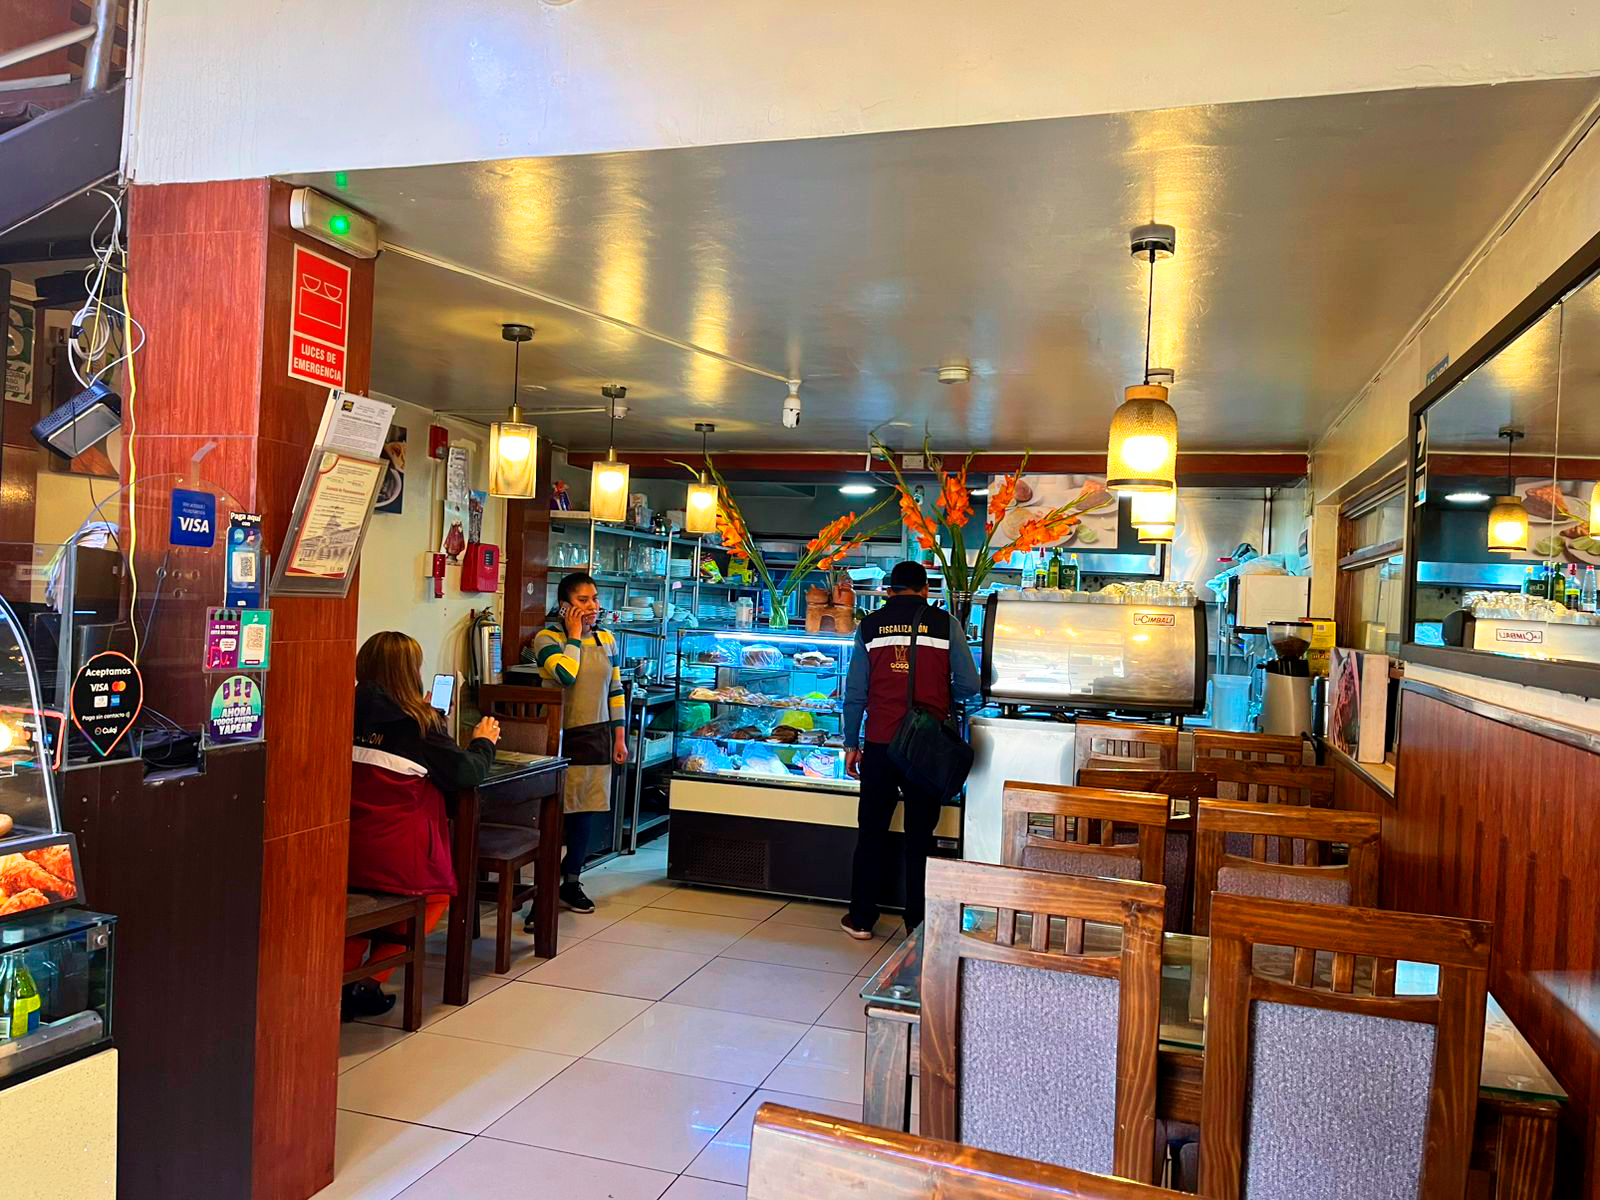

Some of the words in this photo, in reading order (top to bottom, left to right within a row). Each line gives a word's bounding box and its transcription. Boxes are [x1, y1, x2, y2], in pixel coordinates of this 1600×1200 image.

[301, 343, 325, 361] LUCES
[326, 351, 337, 365] DE
[293, 356, 342, 382] EMERGENCIA
[230, 512, 246, 522] Paga
[247, 513, 262, 522] aquí
[178, 516, 209, 533] VISA
[879, 622, 928, 634] FISCALIZAÓN
[85, 668, 132, 678] Aceptamos
[90, 682, 109, 693] VISA
[221, 706, 252, 718] AHORA
[213, 718, 234, 727] TODOS
[234, 715, 259, 724] PUEDEN
[102, 725, 118, 735] Culqi
[219, 722, 253, 736] YAPEAR
